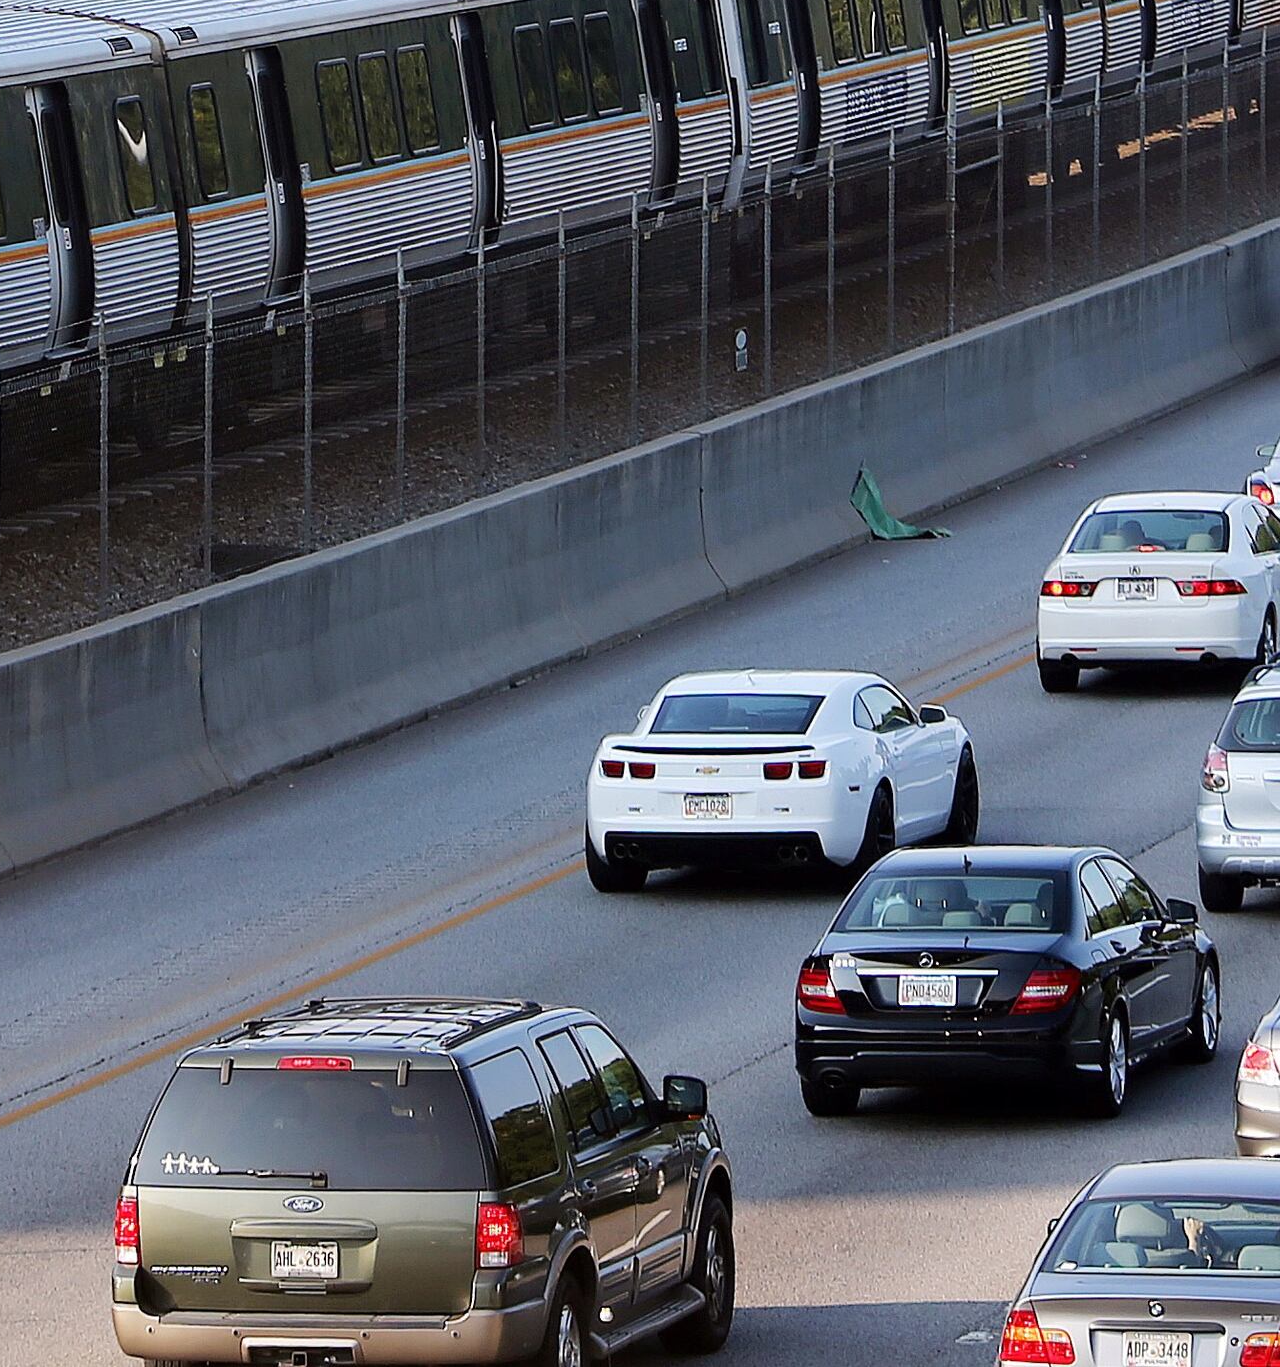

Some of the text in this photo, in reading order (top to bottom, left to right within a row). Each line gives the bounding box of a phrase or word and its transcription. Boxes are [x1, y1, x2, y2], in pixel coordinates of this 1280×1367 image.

[688, 799, 728, 813] PMC1028
[276, 1251, 335, 1267] AHL 2636
[1127, 1341, 1188, 1359] ADP 3448
